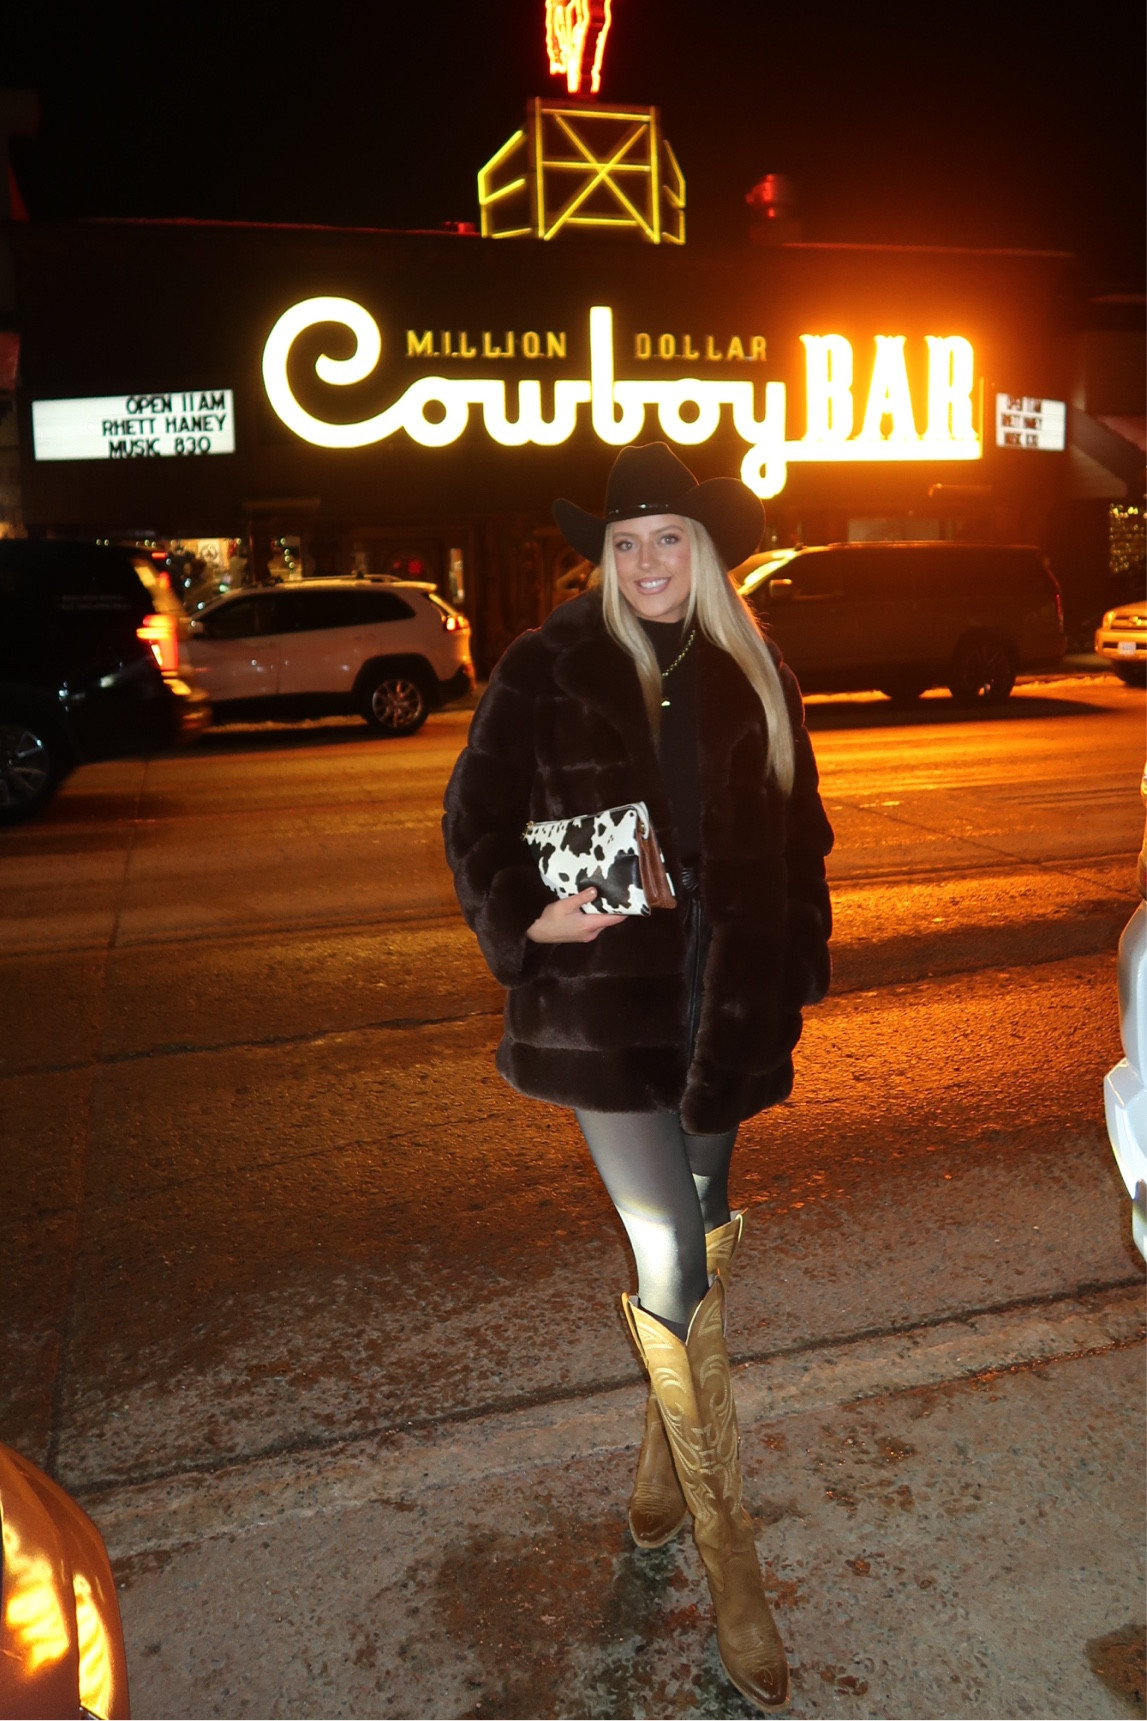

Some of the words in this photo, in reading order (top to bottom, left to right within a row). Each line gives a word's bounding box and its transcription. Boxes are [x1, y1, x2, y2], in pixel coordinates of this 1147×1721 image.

[407, 329, 567, 358] MILLION
[635, 333, 767, 361] DOLLAR
[126, 394, 173, 414] OPEN
[262, 296, 787, 499] Cowboy
[800, 333, 979, 441] BAR
[102, 417, 155, 436] RHETT
[165, 414, 226, 433] HANEY
[109, 438, 161, 458] MUSIC
[174, 436, 211, 454] 830
